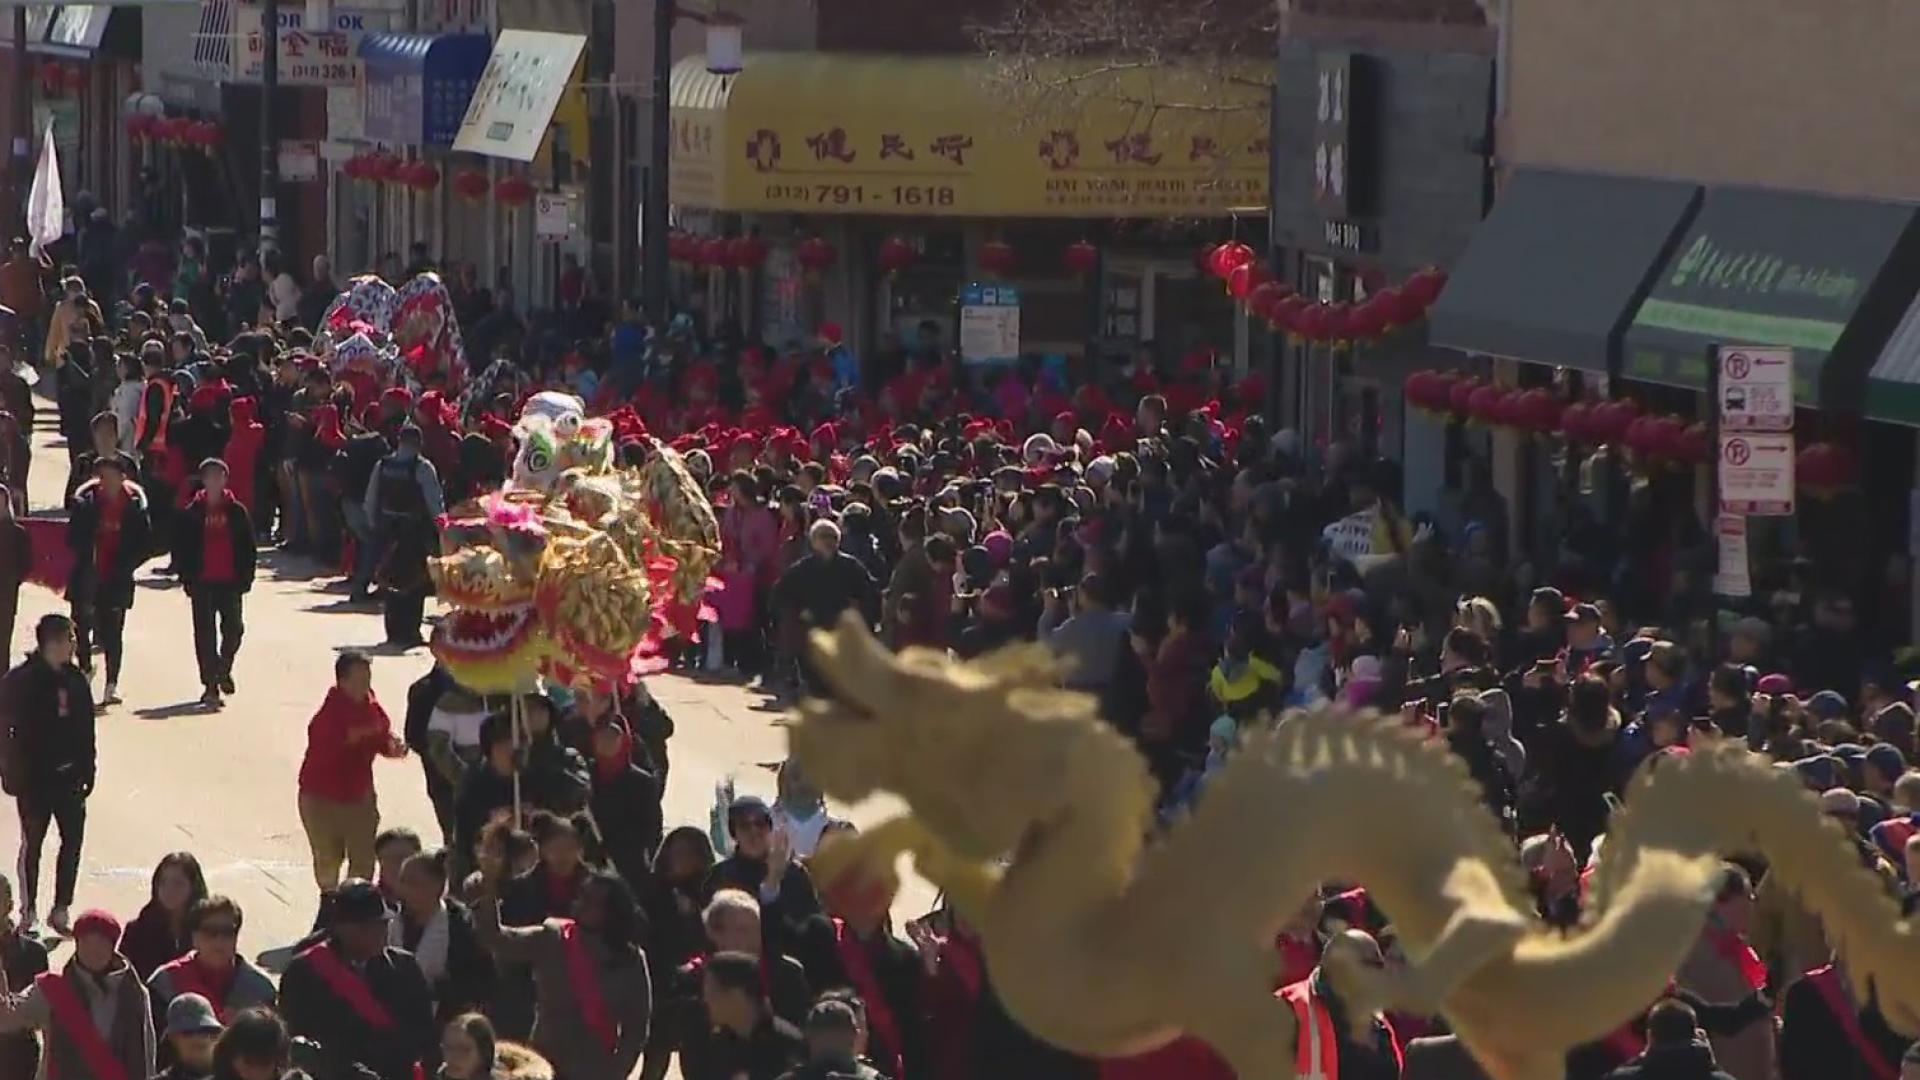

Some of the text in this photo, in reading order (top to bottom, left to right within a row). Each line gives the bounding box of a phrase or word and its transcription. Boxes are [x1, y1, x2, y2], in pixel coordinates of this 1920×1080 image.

[766, 184, 810, 201] (312)
[815, 184, 864, 203] 791
[893, 185, 954, 206] 1618
